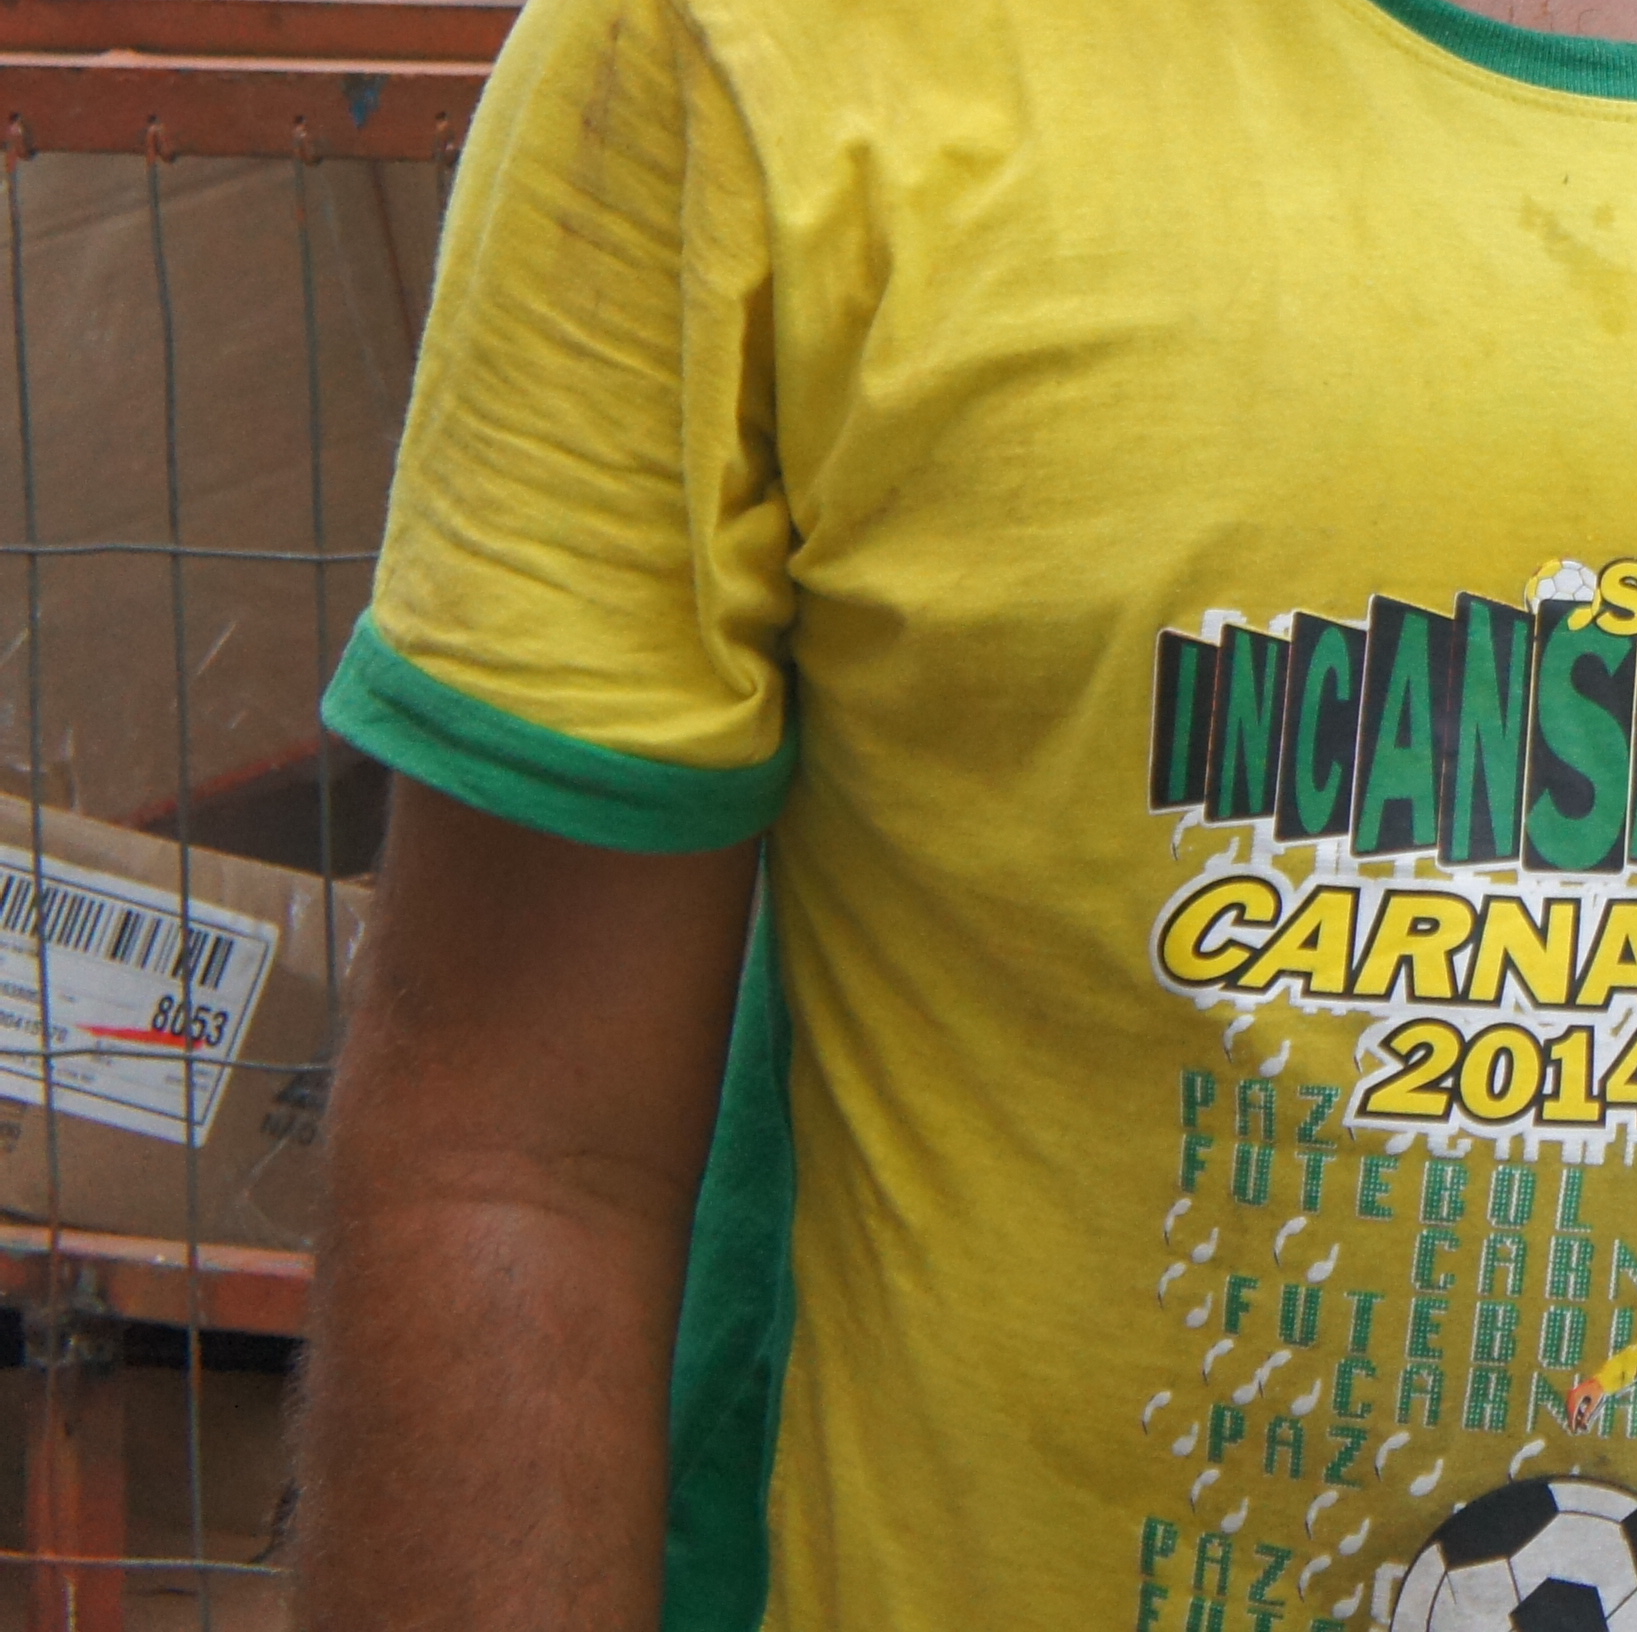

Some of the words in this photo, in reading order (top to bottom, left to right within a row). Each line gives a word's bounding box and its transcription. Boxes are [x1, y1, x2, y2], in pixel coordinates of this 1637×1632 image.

[1180, 1069, 1342, 1148] PAZ
[1180, 1133, 1592, 1233] FUTEBOL
[1207, 1402, 1368, 1488] PAZ
[1141, 1516, 1294, 1606] PAZ
